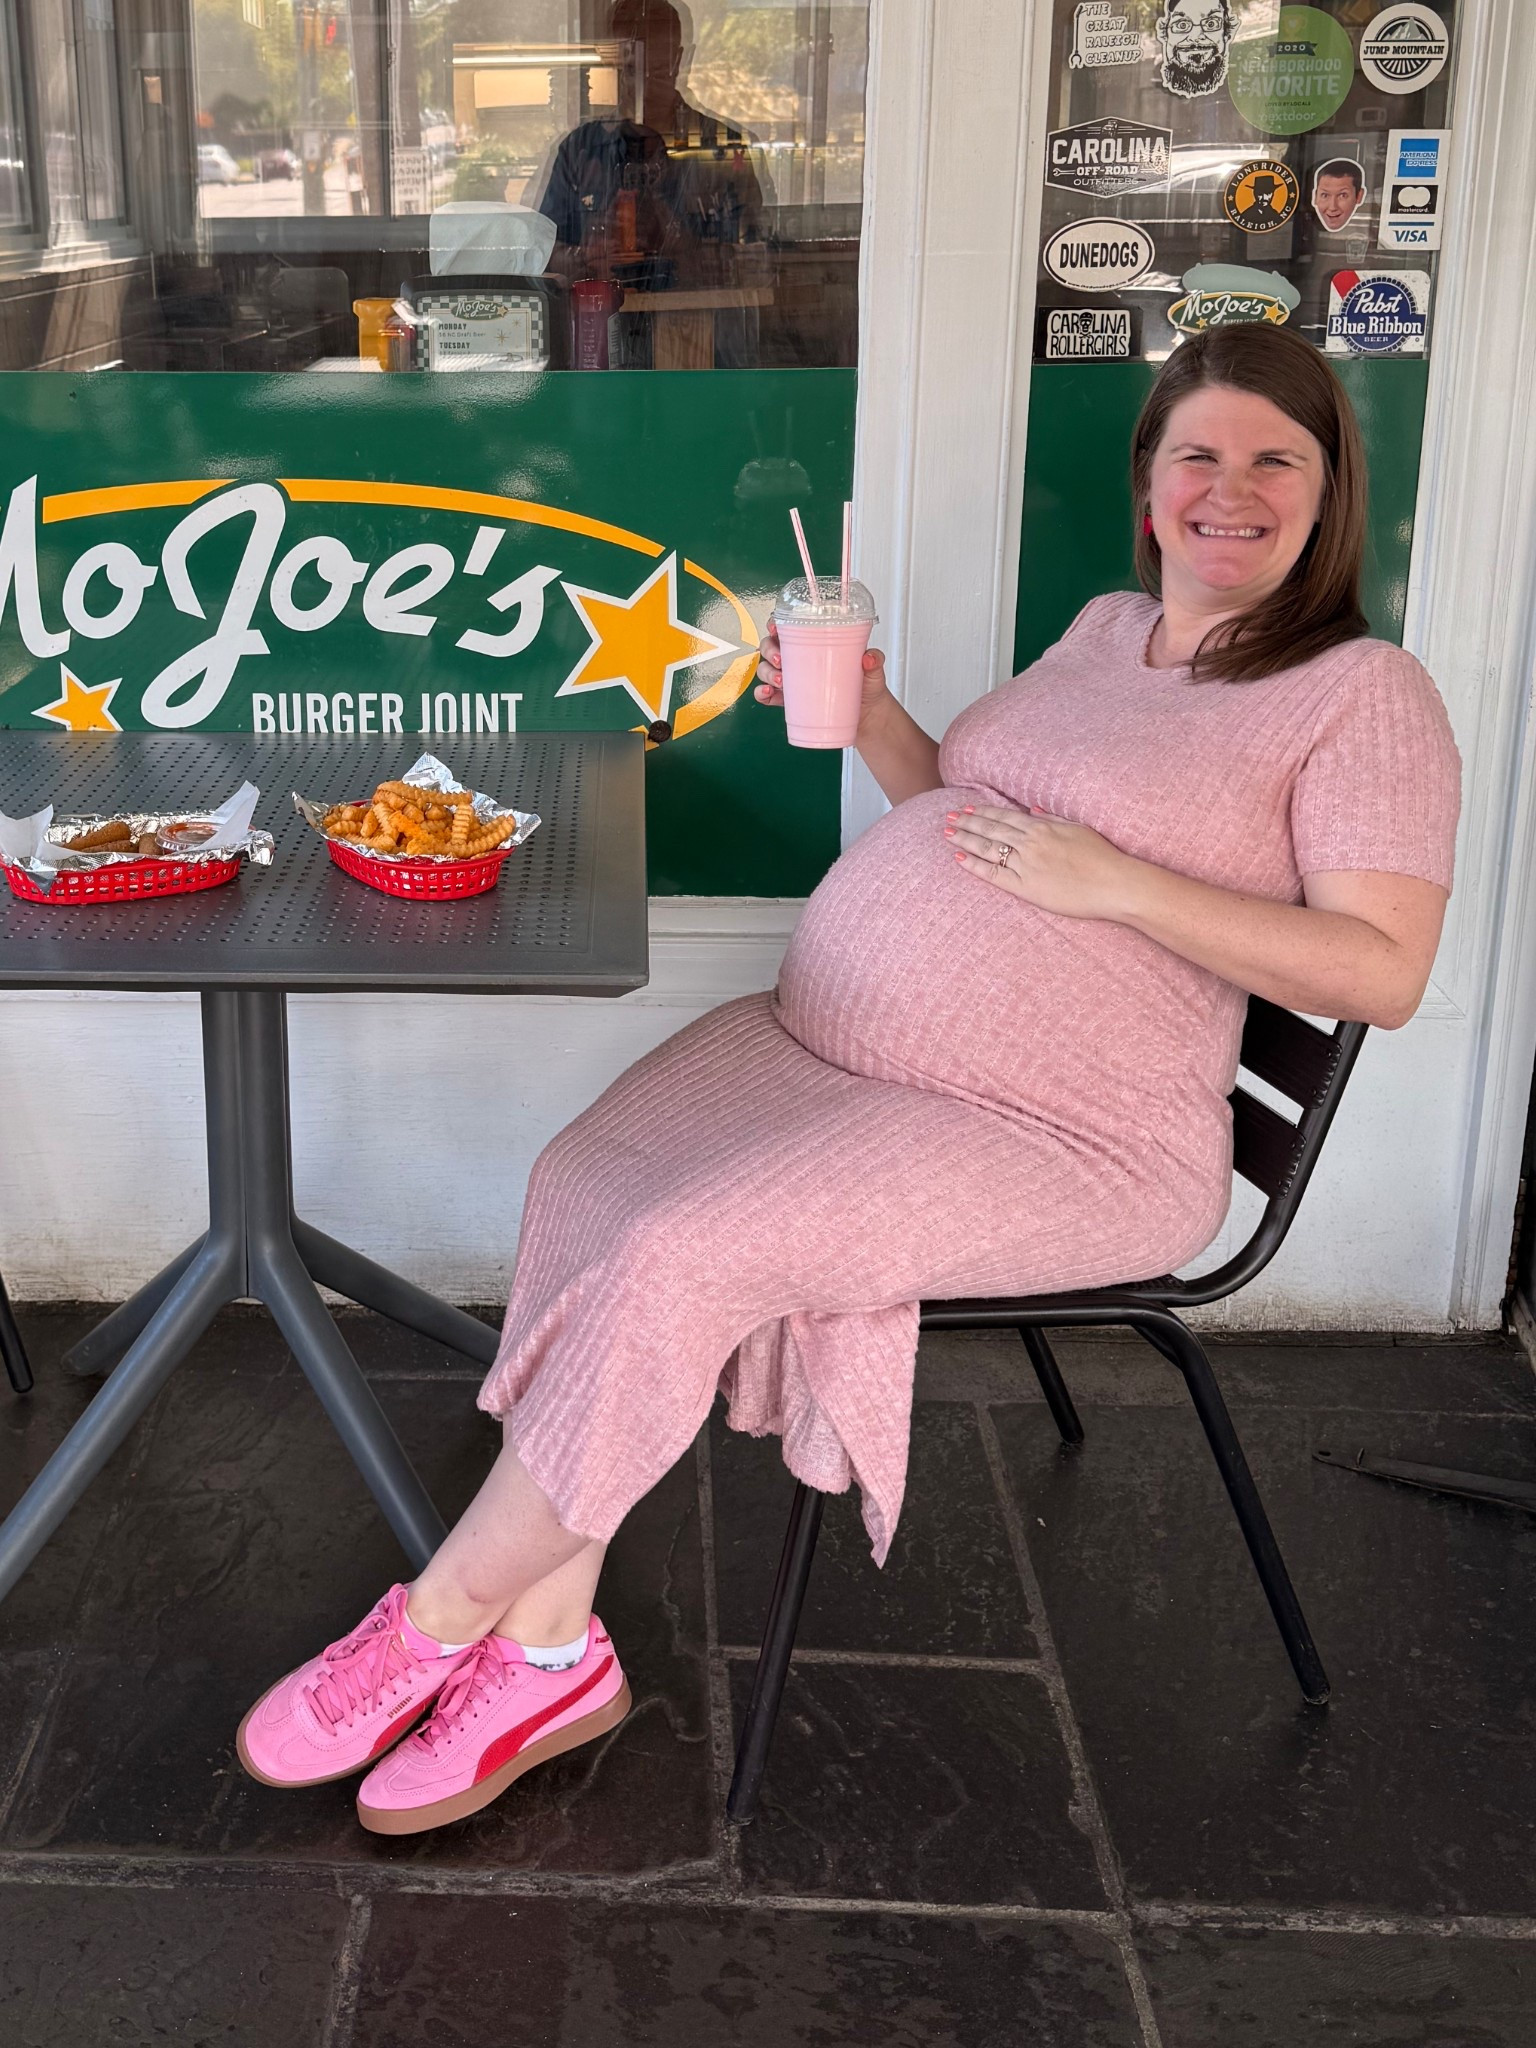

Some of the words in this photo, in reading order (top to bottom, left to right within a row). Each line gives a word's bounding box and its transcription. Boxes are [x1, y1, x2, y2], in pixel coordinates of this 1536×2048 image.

[1085, 3, 1109, 16] THE
[1085, 18, 1125, 32] GREAT
[1085, 33, 1139, 48] RALEIGH
[1277, 44, 1306, 52] 2020
[1085, 50, 1141, 64] CLEANUP
[1363, 46, 1390, 55] JUMP
[1392, 45, 1445, 55] MOUNTAIN
[1239, 58, 1341, 73] NEIGHBORHOOD
[1236, 74, 1340, 97] FAVORITE
[1260, 110, 1316, 121] nextdoor
[1052, 137, 1167, 165] CAROLINA
[1076, 165, 1139, 176] OFF-ROAD
[1231, 162, 1293, 187] LONERIDER
[1073, 177, 1139, 186] OUTFITTERS
[1280, 205, 1292, 219] NC
[1392, 230, 1428, 242] VISA
[1059, 242, 1139, 268] DUNEDOGS
[455, 299, 497, 318] MoJoe's
[1179, 289, 1264, 325] MoJoe's
[1354, 288, 1403, 314] Pabst
[1330, 316, 1365, 335] Blue
[1367, 315, 1422, 335] Ribbon
[1050, 335, 1127, 356] ROLLERGIRLS
[252, 692, 404, 733] BURGER
[416, 692, 523, 733] JOINT
